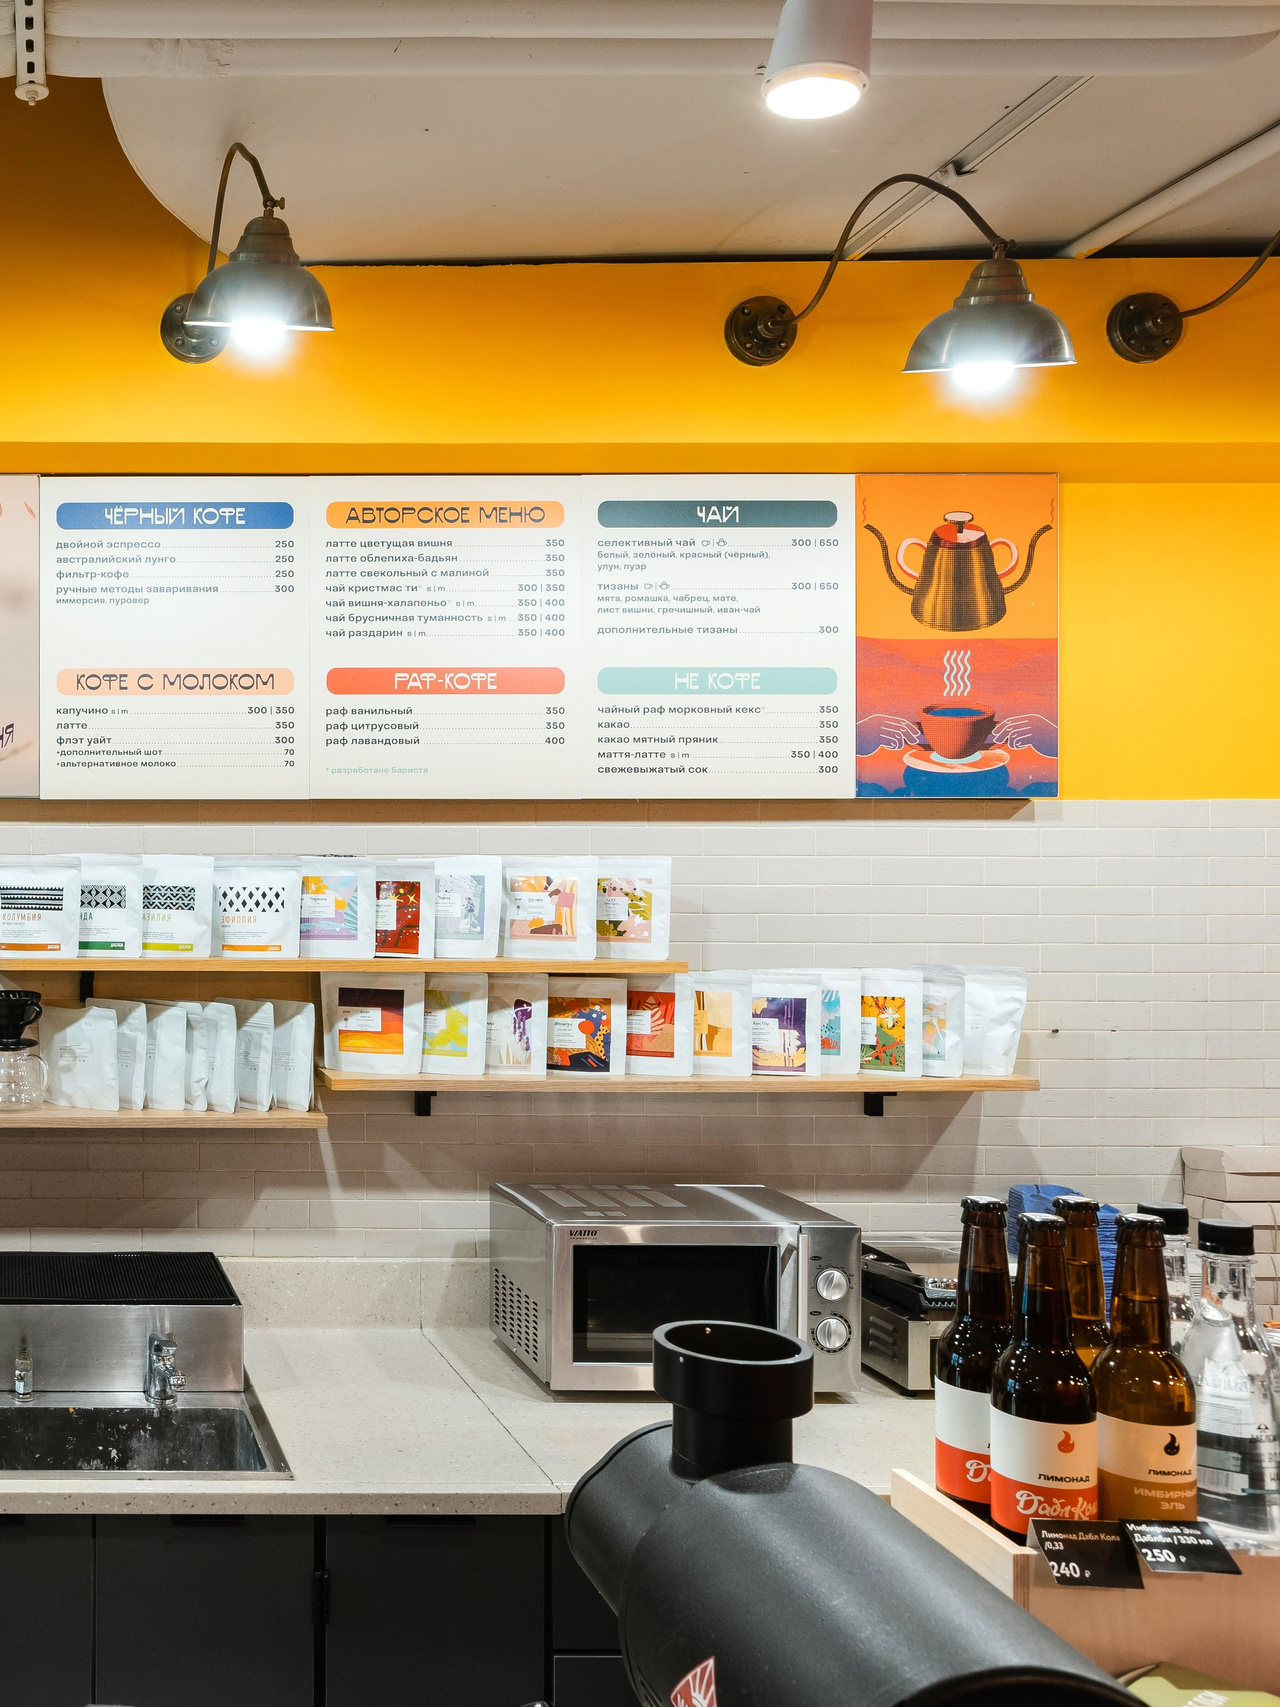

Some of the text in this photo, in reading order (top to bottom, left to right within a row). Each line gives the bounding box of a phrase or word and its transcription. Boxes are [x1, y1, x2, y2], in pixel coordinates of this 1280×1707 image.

[105, 506, 246, 525] ЧЁРНЫЙ КОФЕ
[345, 506, 546, 524] АВТОРСКОЕ МЕНЮ
[696, 505, 739, 523] ЧАЙ
[56, 540, 295, 550] двойной эспрессо 250
[325, 540, 357, 548] латте
[360, 540, 415, 550] цветущая
[545, 539, 565, 547] 350
[597, 538, 839, 547] селективный чай 300 650
[56, 555, 295, 565] австралийский лунго 250
[325, 554, 565, 564] латте облепиха-бадьян 350
[597, 550, 631, 560] белый,
[680, 551, 721, 560] красный
[597, 563, 646, 572] улун, пуэр
[56, 569, 295, 580] фильтр-кофе 250
[325, 570, 357, 578] латте
[360, 568, 428, 578] свекольный
[440, 568, 490, 577] малиной
[545, 569, 565, 577] 350
[56, 585, 295, 595] ручные методы заваривания 300
[326, 584, 565, 594] чай кристмас 300 350
[597, 582, 839, 591] тизаны 300 650
[109, 597, 149, 606] пуровер
[326, 599, 345, 607] чай
[517, 599, 537, 607] 350
[545, 599, 565, 607] 400
[625, 595, 671, 604] ромашка,
[673, 594, 711, 604] чабрец,
[658, 606, 715, 615] гречишный,
[326, 612, 565, 623] чай брусничная туманность 350 400
[326, 629, 565, 638] чай раздарин 350 400
[597, 626, 839, 635] дополнительные тизаны 300
[76, 674, 274, 690] КОФЕ С МОЛОКОМ
[394, 673, 497, 690] РАФ-КОФЕ
[674, 672, 761, 689] НЕ КОФЕ
[56, 707, 108, 716] капучино
[326, 706, 565, 717] раф ванильный 350
[598, 705, 640, 714] чайный
[643, 705, 666, 716] раф
[668, 705, 732, 715] морковный
[819, 706, 839, 714] 350
[56, 722, 88, 730] латте
[326, 721, 565, 732] раф цитрусовый 350
[598, 721, 839, 729] какао 350
[56, 735, 295, 746] флэт уайт 300
[326, 736, 565, 747] раф лавандовый 400
[598, 735, 839, 745] какао мятный пряник 350
[598, 751, 839, 759] маття-латте 350 400
[331, 766, 429, 774] разработано бариста
[598, 765, 685, 773] свежевыжатый
[818, 766, 839, 774] 300
[2, 912, 42, 921] КОЛУМБИЯ
[1038, 1473, 1090, 1483] ЛИМОНАД
[1160, 1501, 1186, 1510] ЭЛЬ
[1126, 1523, 1201, 1535] Имбирный Эль
[1041, 1530, 1120, 1542] Лимонад Дабл Кола
[1134, 1534, 1214, 1546] Даблби 330 мл
[1141, 1549, 1177, 1563] 250
[1049, 1561, 1080, 1578] 240
